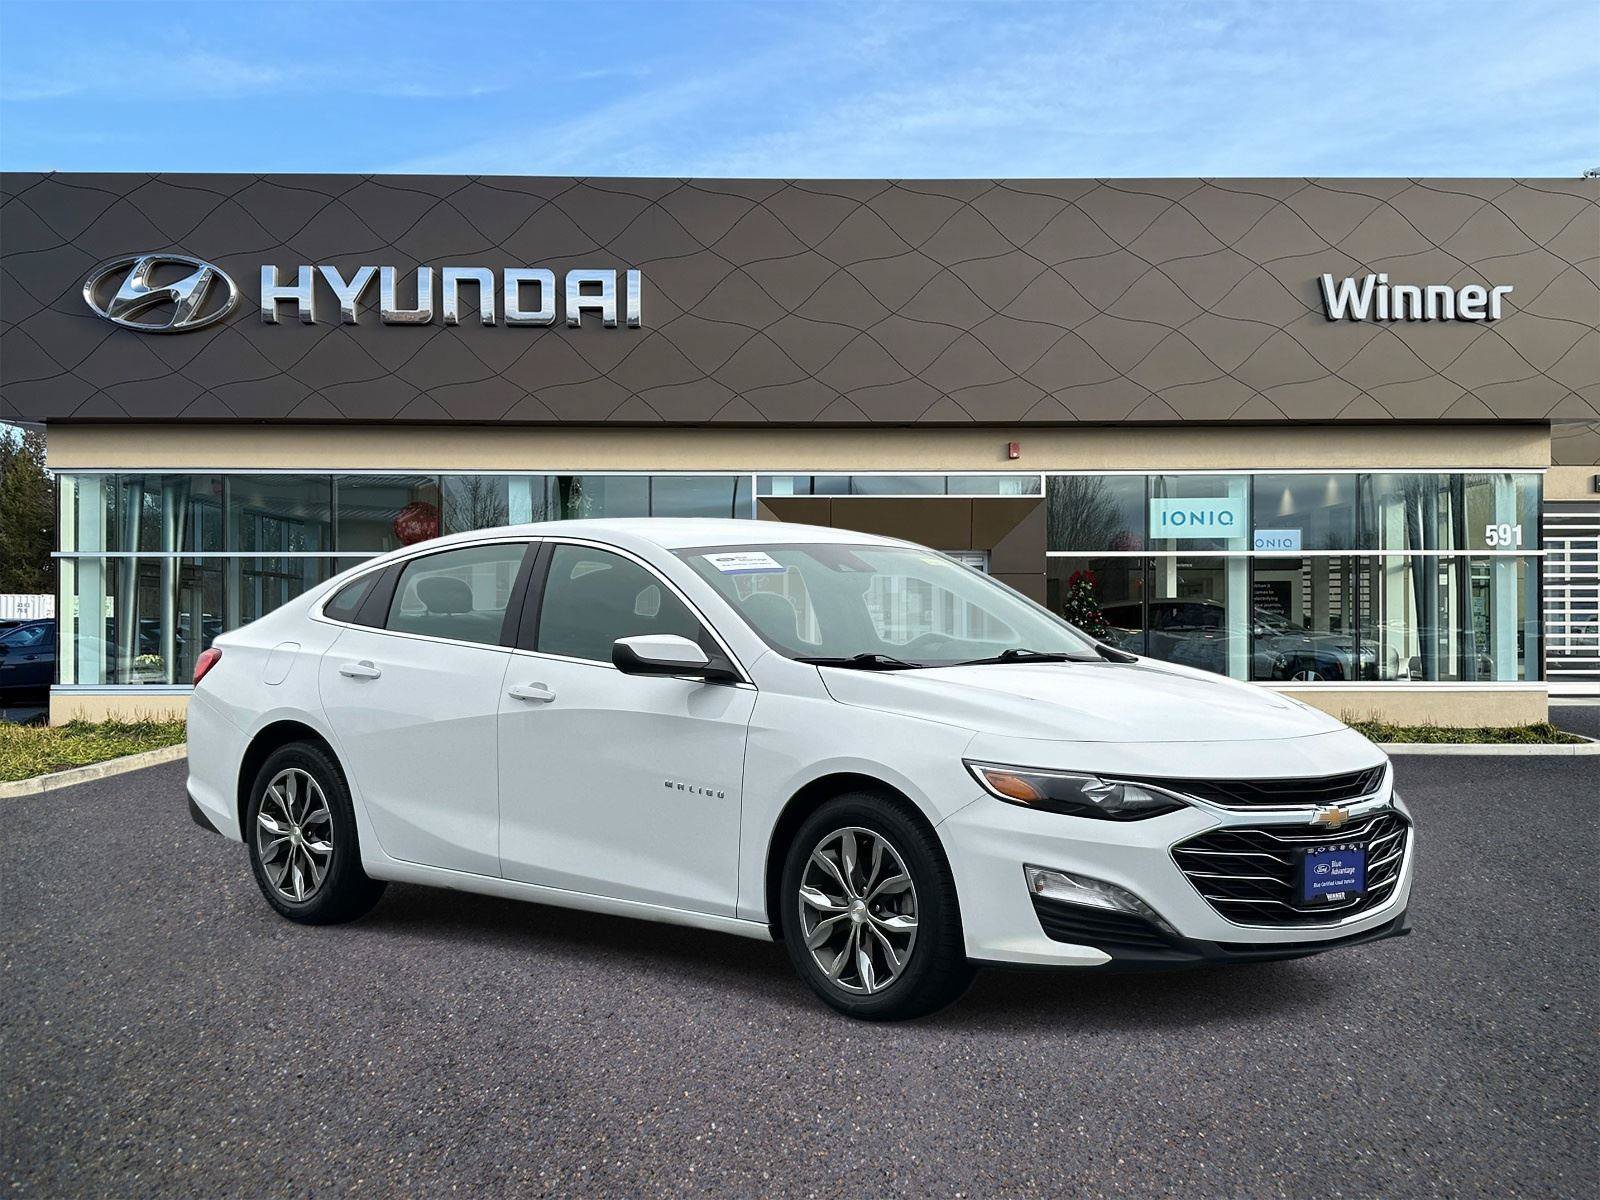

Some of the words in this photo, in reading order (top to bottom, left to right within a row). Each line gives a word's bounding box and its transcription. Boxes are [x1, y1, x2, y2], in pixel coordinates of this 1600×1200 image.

[261, 265, 642, 328] HYUNDAI
[1320, 272, 1515, 322] Winner
[1162, 511, 1234, 526] IONIQ
[1255, 538, 1293, 548] ONIQ
[1485, 523, 1523, 546] 591
[664, 779, 725, 799] MALIBU
[1331, 860, 1342, 868] Blue
[1331, 867, 1355, 875] Advantage
